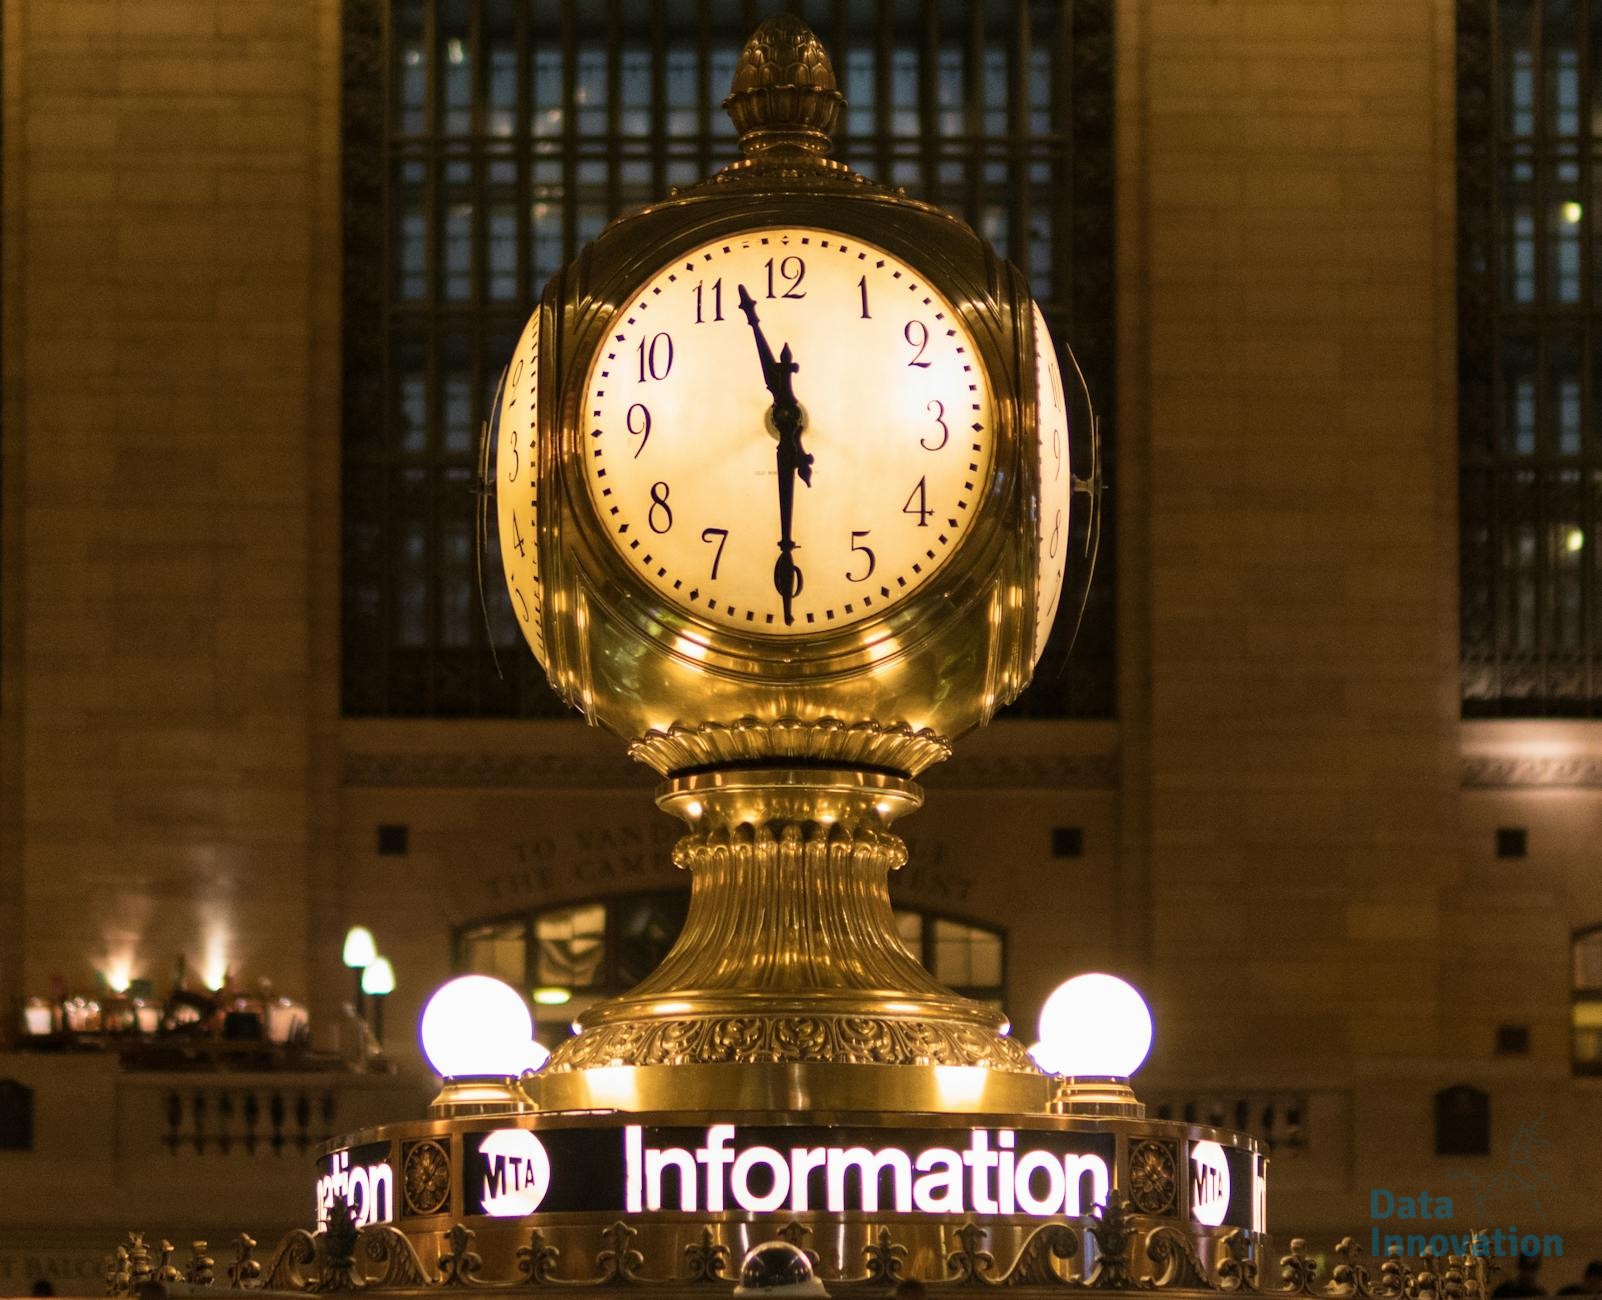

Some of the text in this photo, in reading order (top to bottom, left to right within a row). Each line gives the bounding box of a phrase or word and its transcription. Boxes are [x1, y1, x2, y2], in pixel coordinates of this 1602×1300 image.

[692, 277, 725, 324] 11
[764, 256, 807, 299] 12
[857, 274, 873, 319] 1
[636, 332, 675, 383] 10
[904, 320, 932, 368] 2
[626, 403, 652, 459] 9
[920, 400, 949, 451] 3
[509, 430, 519, 482] 3
[1053, 429, 1061, 481] 9
[648, 481, 673, 534] 8
[902, 475, 935, 527] 4
[512, 508, 526, 558] 4
[701, 528, 729, 580] 7
[845, 530, 876, 582] 5
[1049, 509, 1061, 559] 8
[481, 1124, 1109, 1218] MTA Information
[1190, 1157, 1223, 1206] MTA
